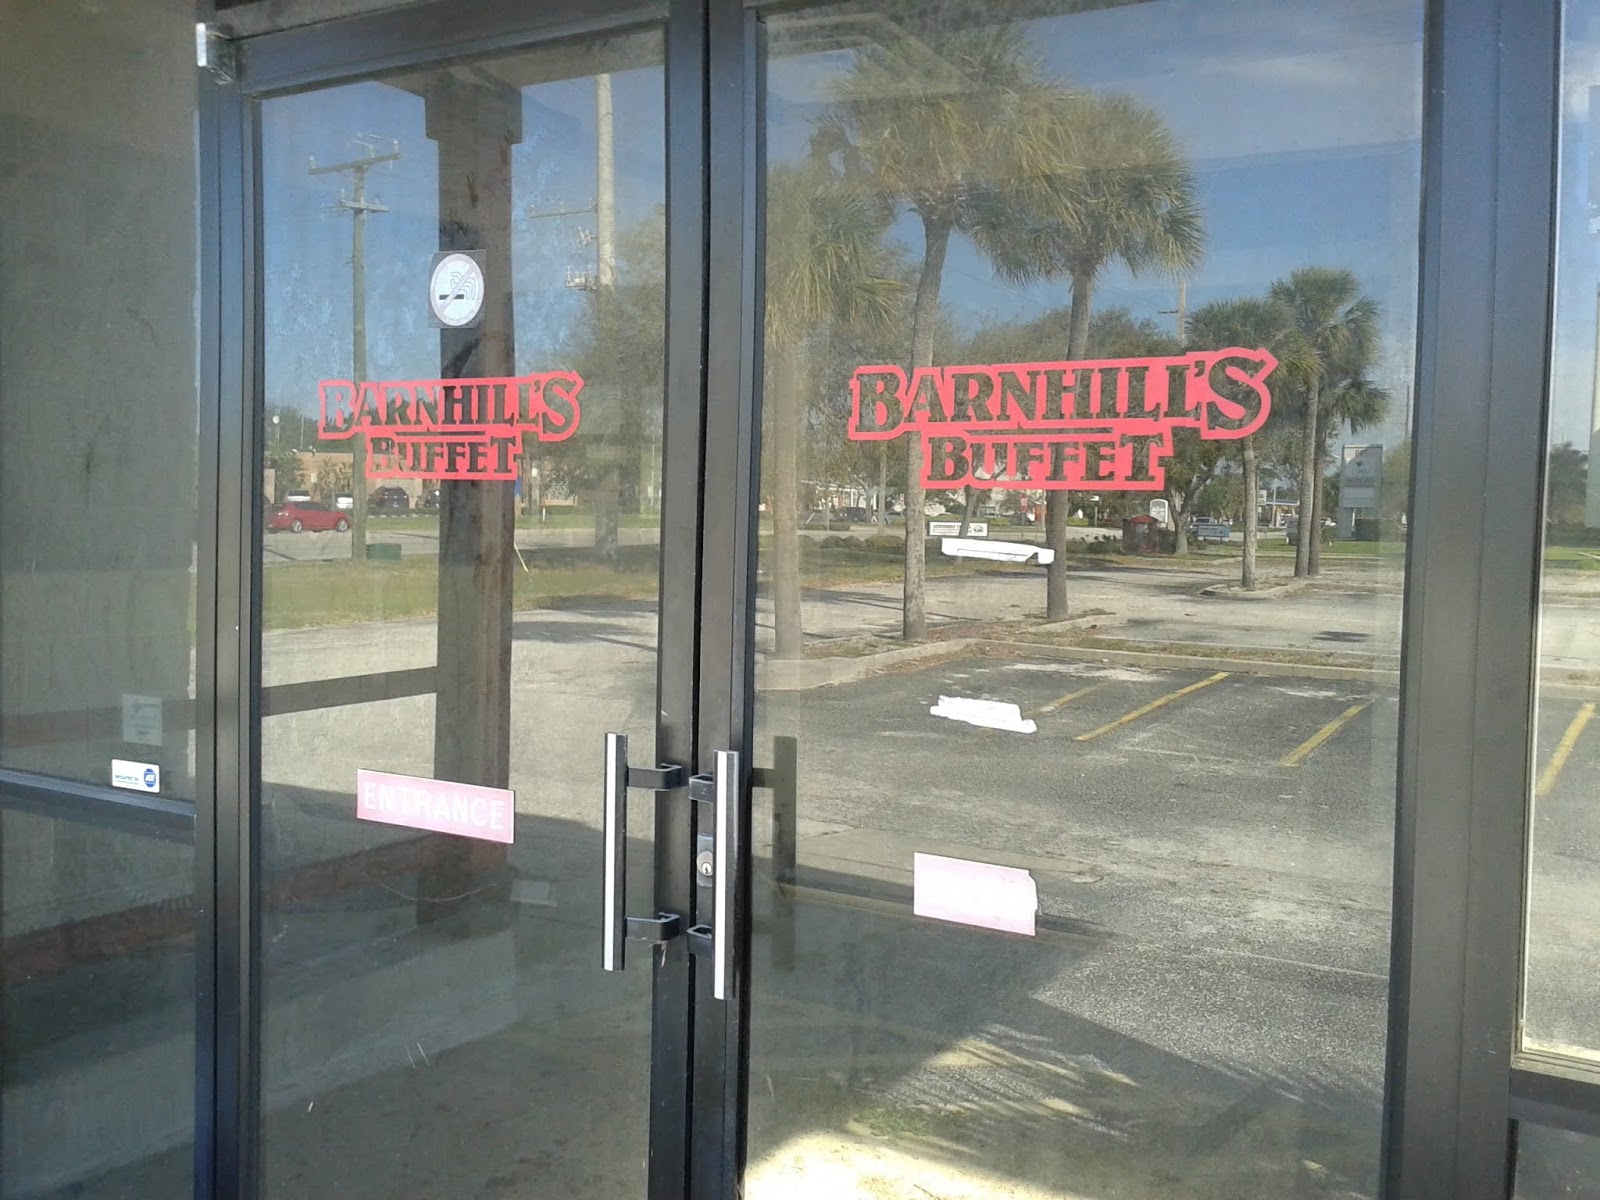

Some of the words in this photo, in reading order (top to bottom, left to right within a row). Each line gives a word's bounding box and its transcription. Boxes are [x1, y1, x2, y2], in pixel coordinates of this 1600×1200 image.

[322, 376, 577, 434] BARNHILL'S
[854, 354, 1268, 433] BARNHILL'S
[370, 436, 517, 474] BUFFET
[927, 433, 1164, 482] BUFFET
[362, 781, 505, 830] ENTRANCE
